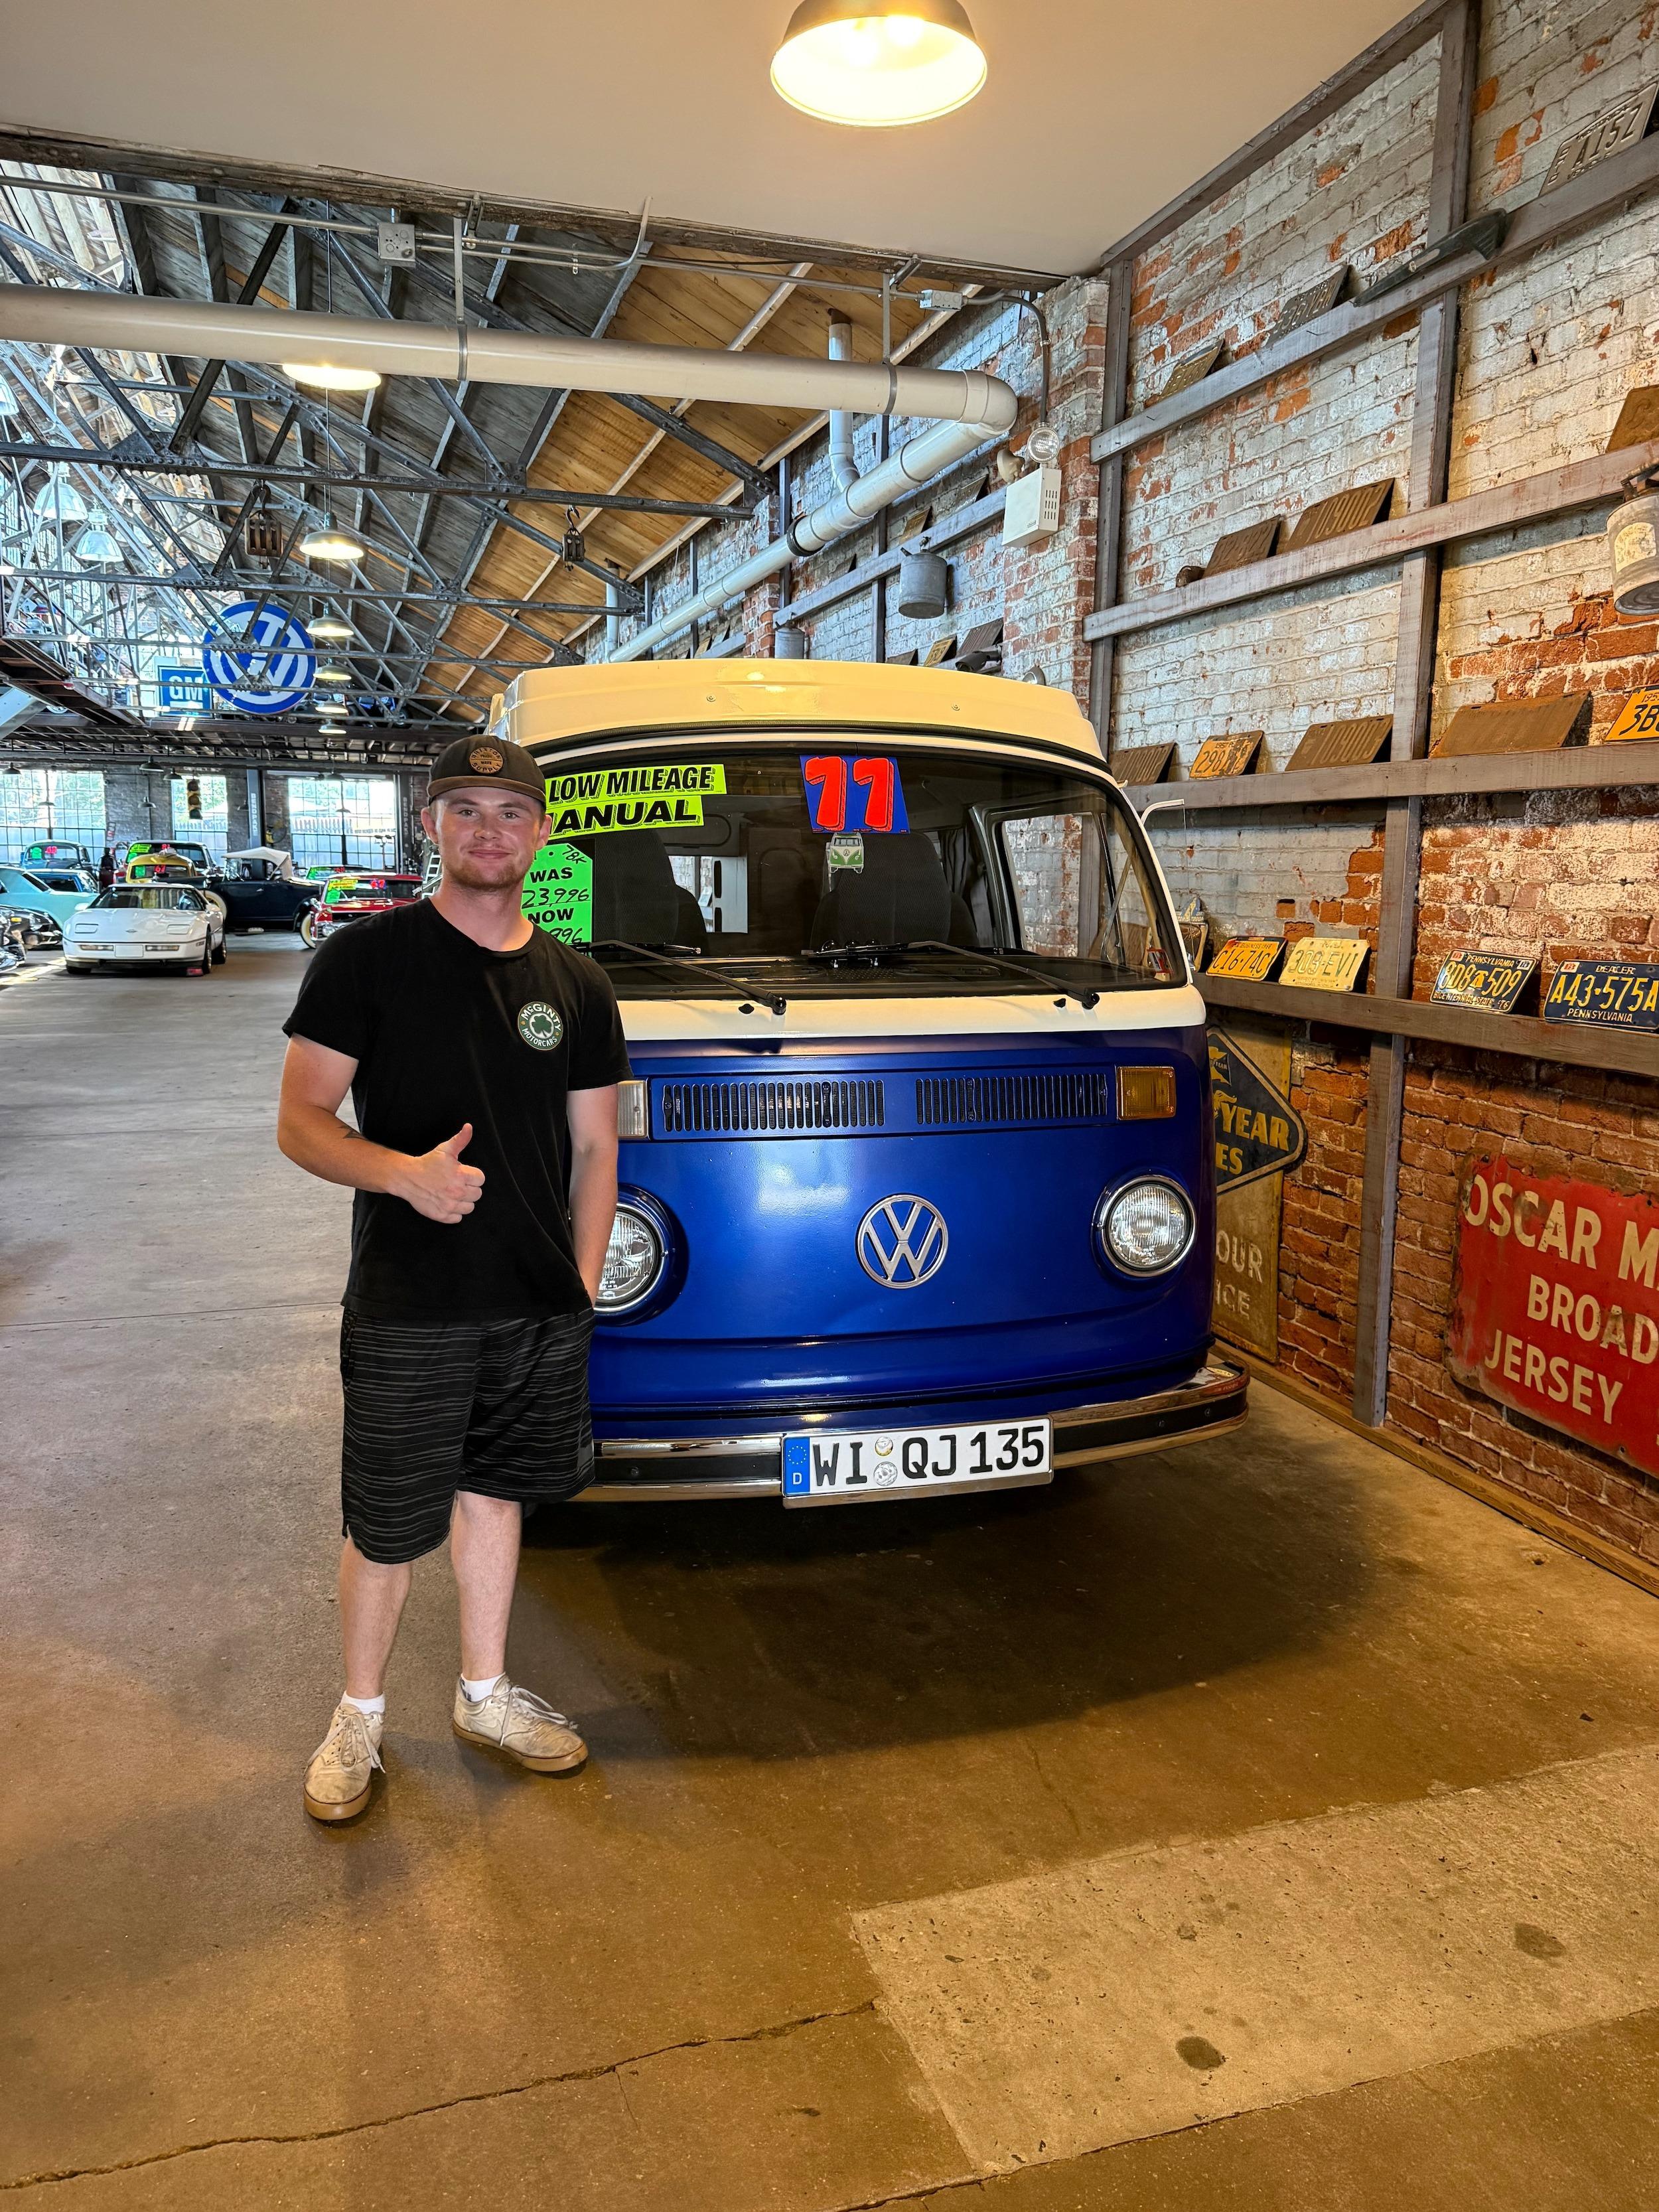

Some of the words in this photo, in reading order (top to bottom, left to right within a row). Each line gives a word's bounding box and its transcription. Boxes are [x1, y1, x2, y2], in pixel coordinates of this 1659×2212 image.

[169, 675, 203, 701] GM
[1619, 703, 1659, 736] 3B
[472, 762, 501, 773] SUPPLY
[548, 773, 605, 805] LOW
[606, 767, 717, 796] MILEAGE
[804, 755, 895, 832] 77
[530, 867, 573, 883] WAS
[528, 907, 575, 924] NOW
[1465, 954, 1516, 968] PENNSYLVANIA
[1595, 965, 1636, 975] DEALER
[1567, 1007, 1633, 1023] PENNSYLVANIA
[522, 1027, 557, 1047] MOTORCARS
[1220, 1102, 1289, 1152] YEAR
[1463, 1173, 1602, 1270] OSCAR
[1527, 1274, 1659, 1365] BROAD
[1484, 1329, 1623, 1425] JERSEY
[812, 1441, 867, 1487] WI
[901, 1434, 957, 1480] QJ
[970, 1425, 1045, 1474] 135
[792, 1472, 802, 1485] D
